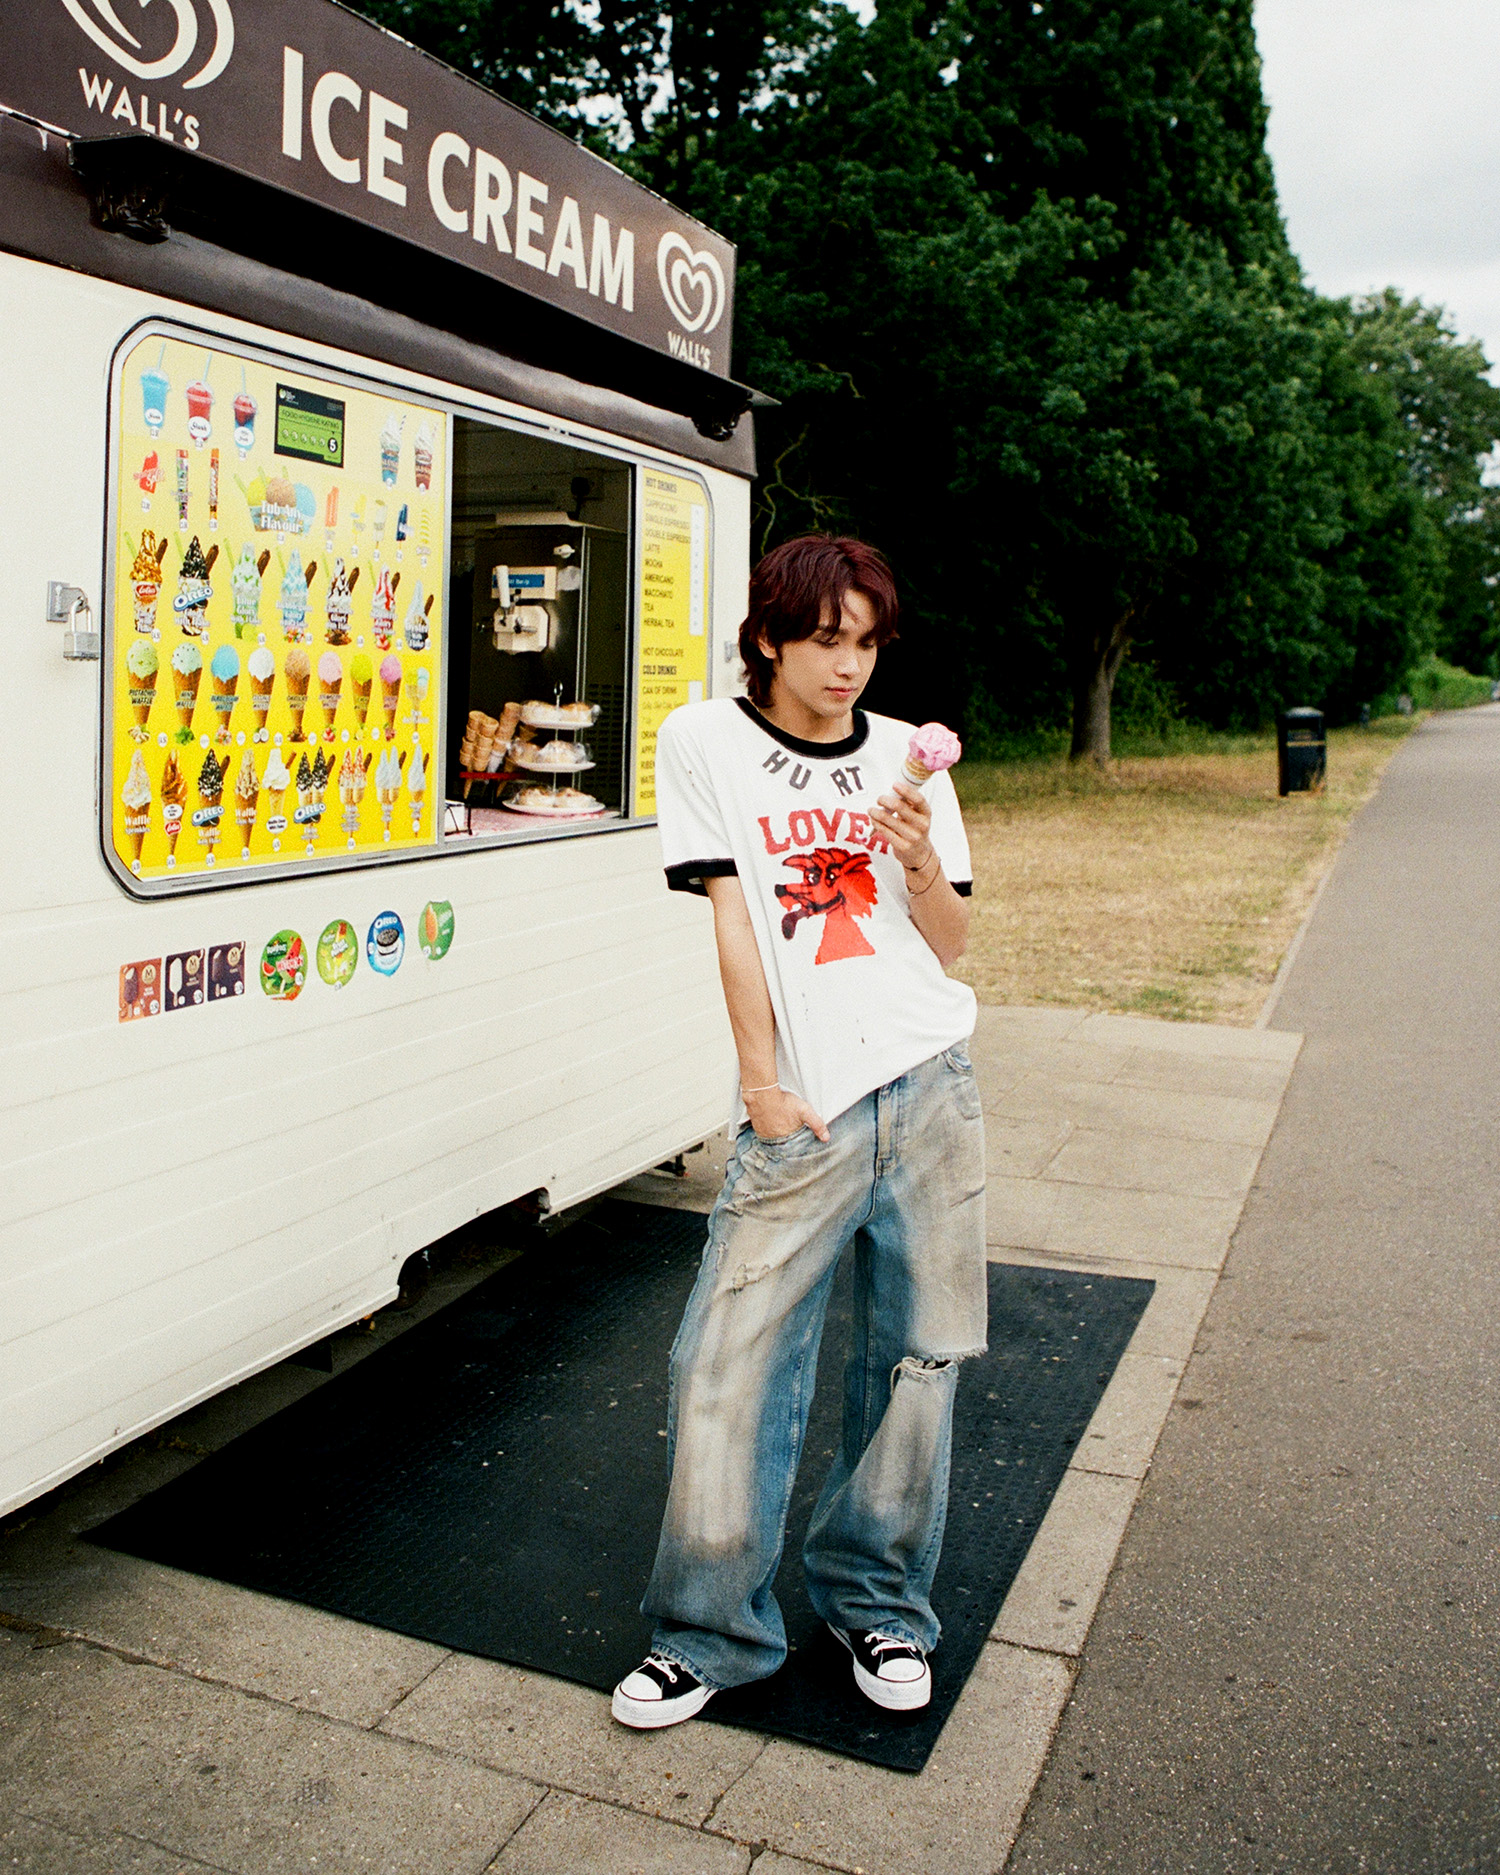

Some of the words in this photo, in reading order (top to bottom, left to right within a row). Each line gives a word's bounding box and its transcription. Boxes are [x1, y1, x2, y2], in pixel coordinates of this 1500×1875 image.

[79, 67, 200, 151] WALL'S
[282, 45, 409, 207] ICE
[427, 131, 635, 312] CREAM
[667, 330, 711, 370] WALL'S
[330, 439, 336, 452] 5
[646, 477, 656, 488] HOT
[658, 478, 677, 493] DRINKS
[261, 500, 281, 516] Tub
[261, 515, 301, 534] Flavour
[174, 587, 213, 609] OREO
[643, 647, 653, 656] HOT
[655, 648, 683, 657] CHOCOLATE
[643, 665, 656, 674] COLD
[658, 665, 677, 675] DRINKS
[131, 696, 153, 706] WAFFLE
[193, 805, 225, 822] OREO
[294, 803, 326, 821] OREO
[124, 815, 152, 826] Waffle
[198, 827, 222, 837] Waffle
[374, 916, 398, 929] OREO
